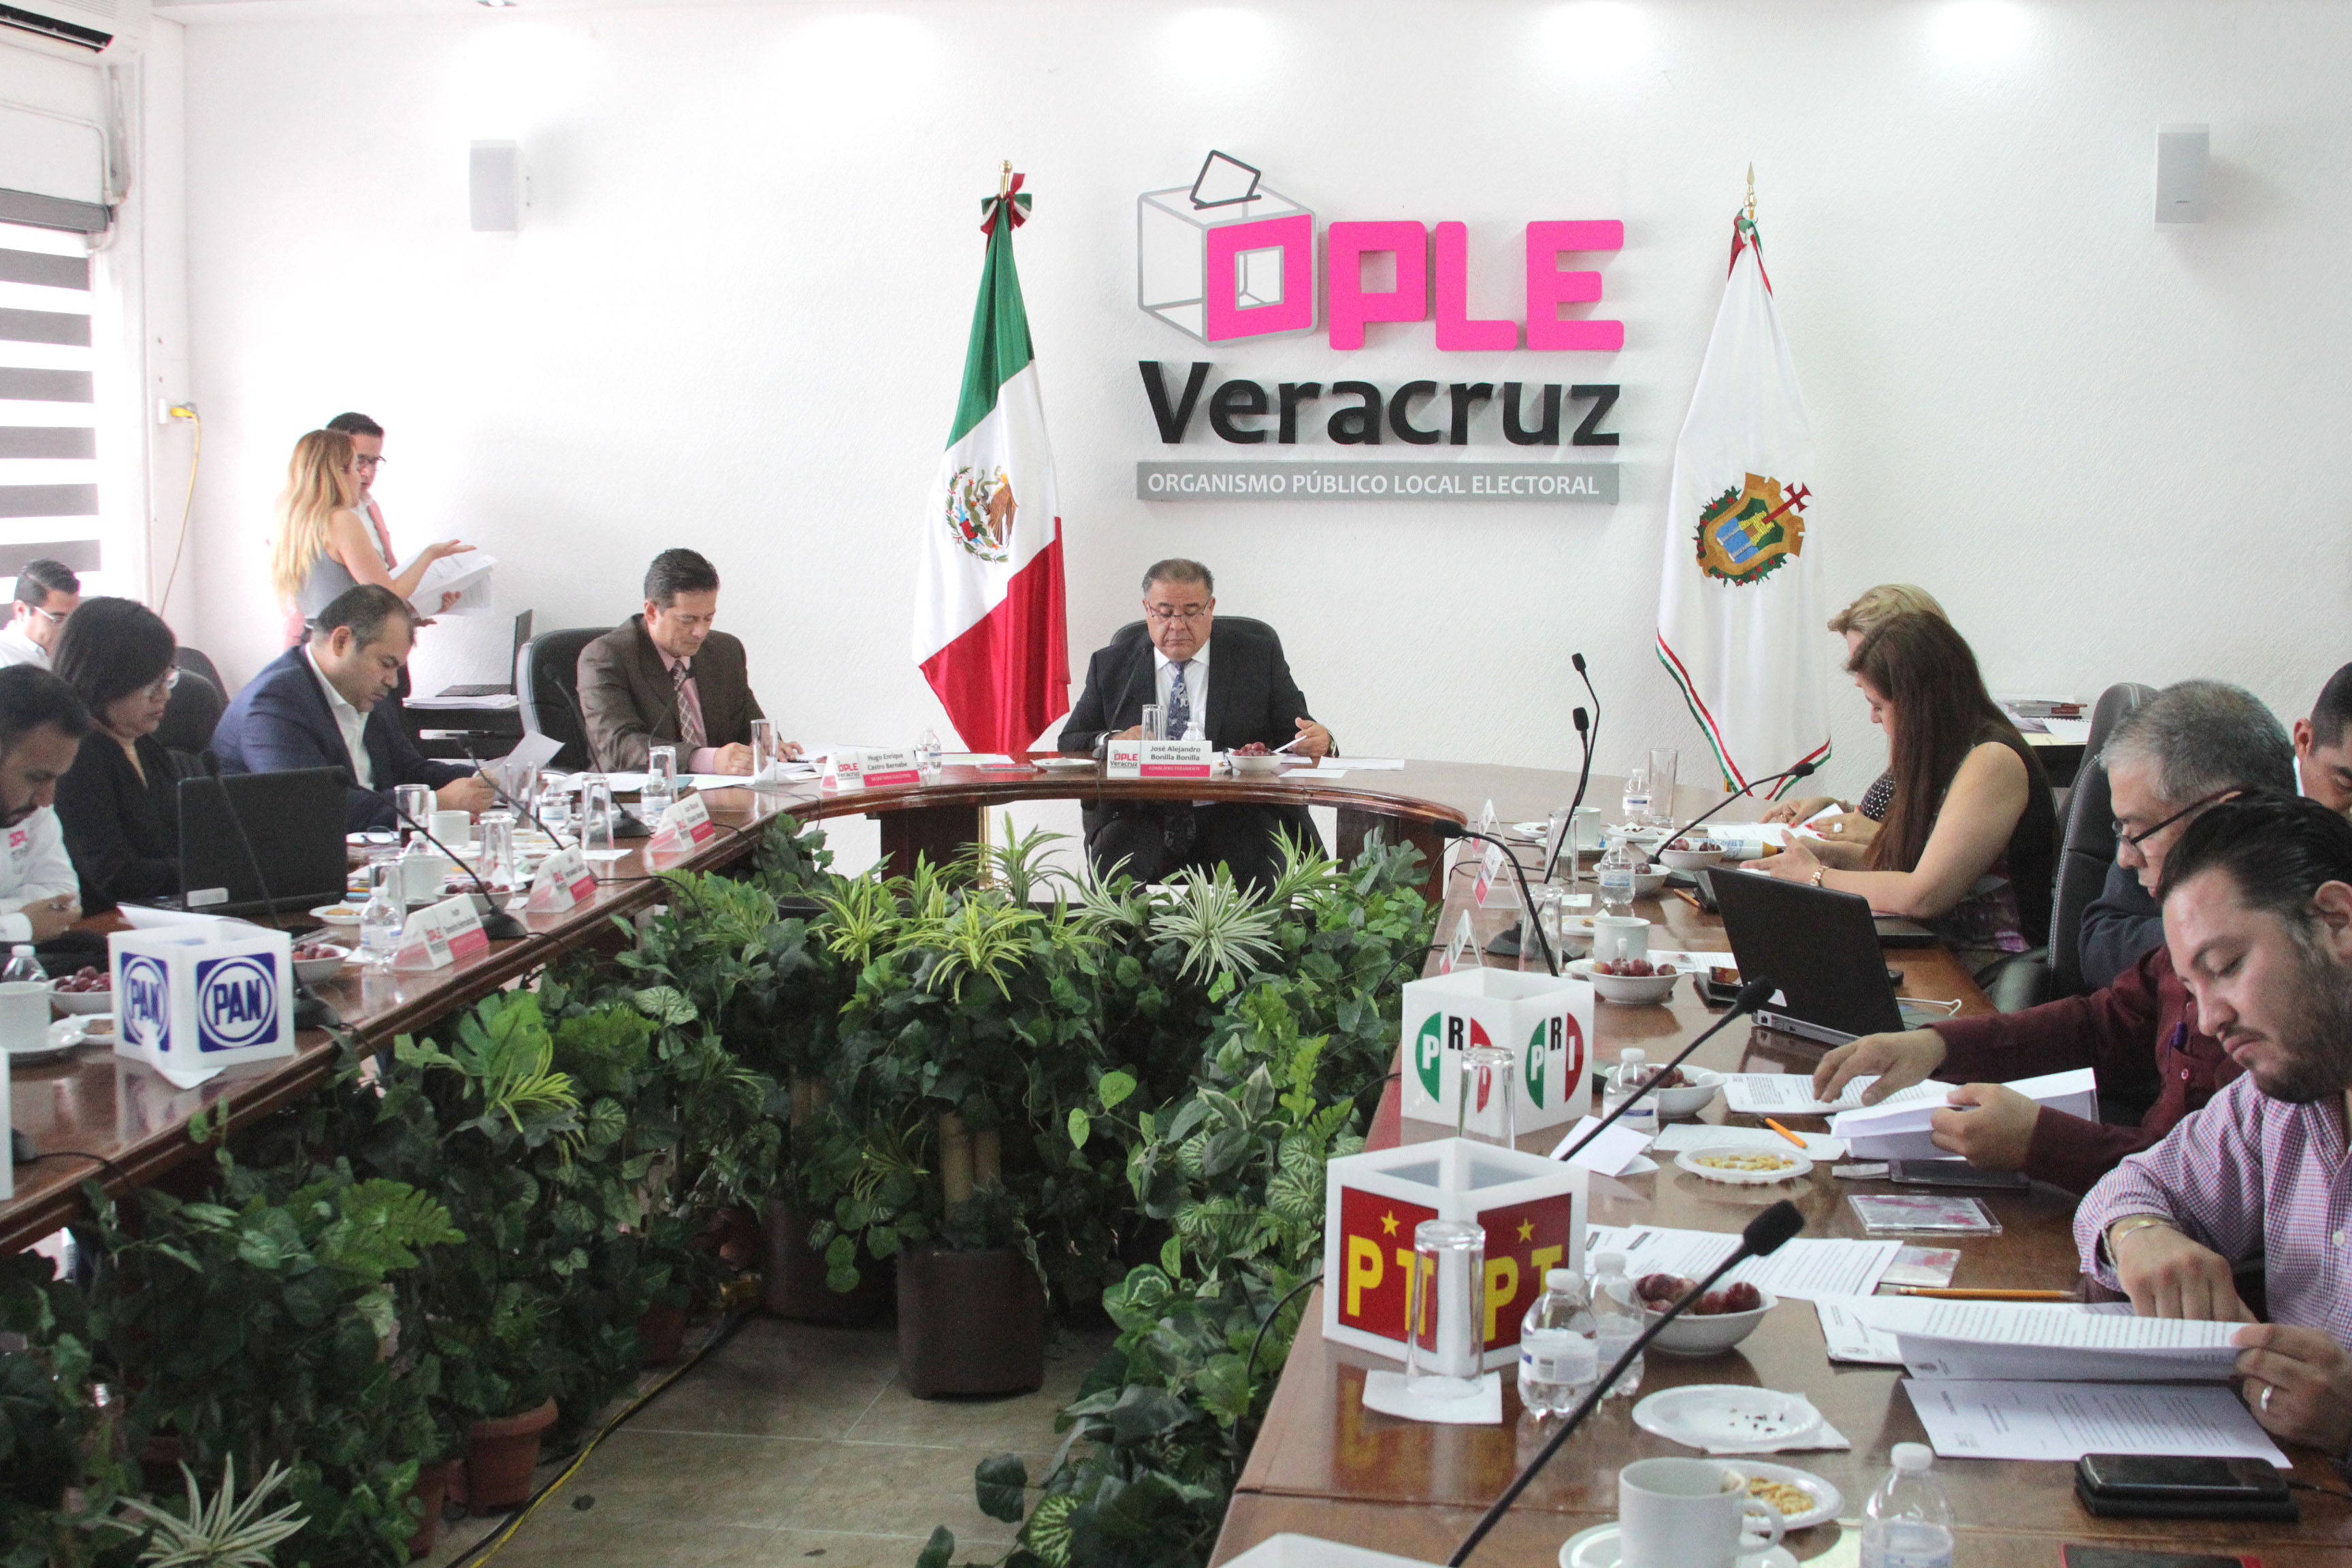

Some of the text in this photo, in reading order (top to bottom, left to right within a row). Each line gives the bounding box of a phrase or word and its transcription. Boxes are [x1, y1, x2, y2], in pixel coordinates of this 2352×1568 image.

[1207, 214, 1625, 351] OPLE
[1138, 361, 1620, 446] Veracruz
[1148, 469, 1600, 496] ORGANISMO PÚBLICO LOCAL ELECTORAL
[868, 754, 883, 763] Hugo
[1114, 753, 1139, 761] OPLE
[131, 977, 162, 1024] PAN
[214, 978, 263, 1026] PAN
[1531, 1016, 1576, 1081] PRI
[1347, 1234, 1435, 1336] PT
